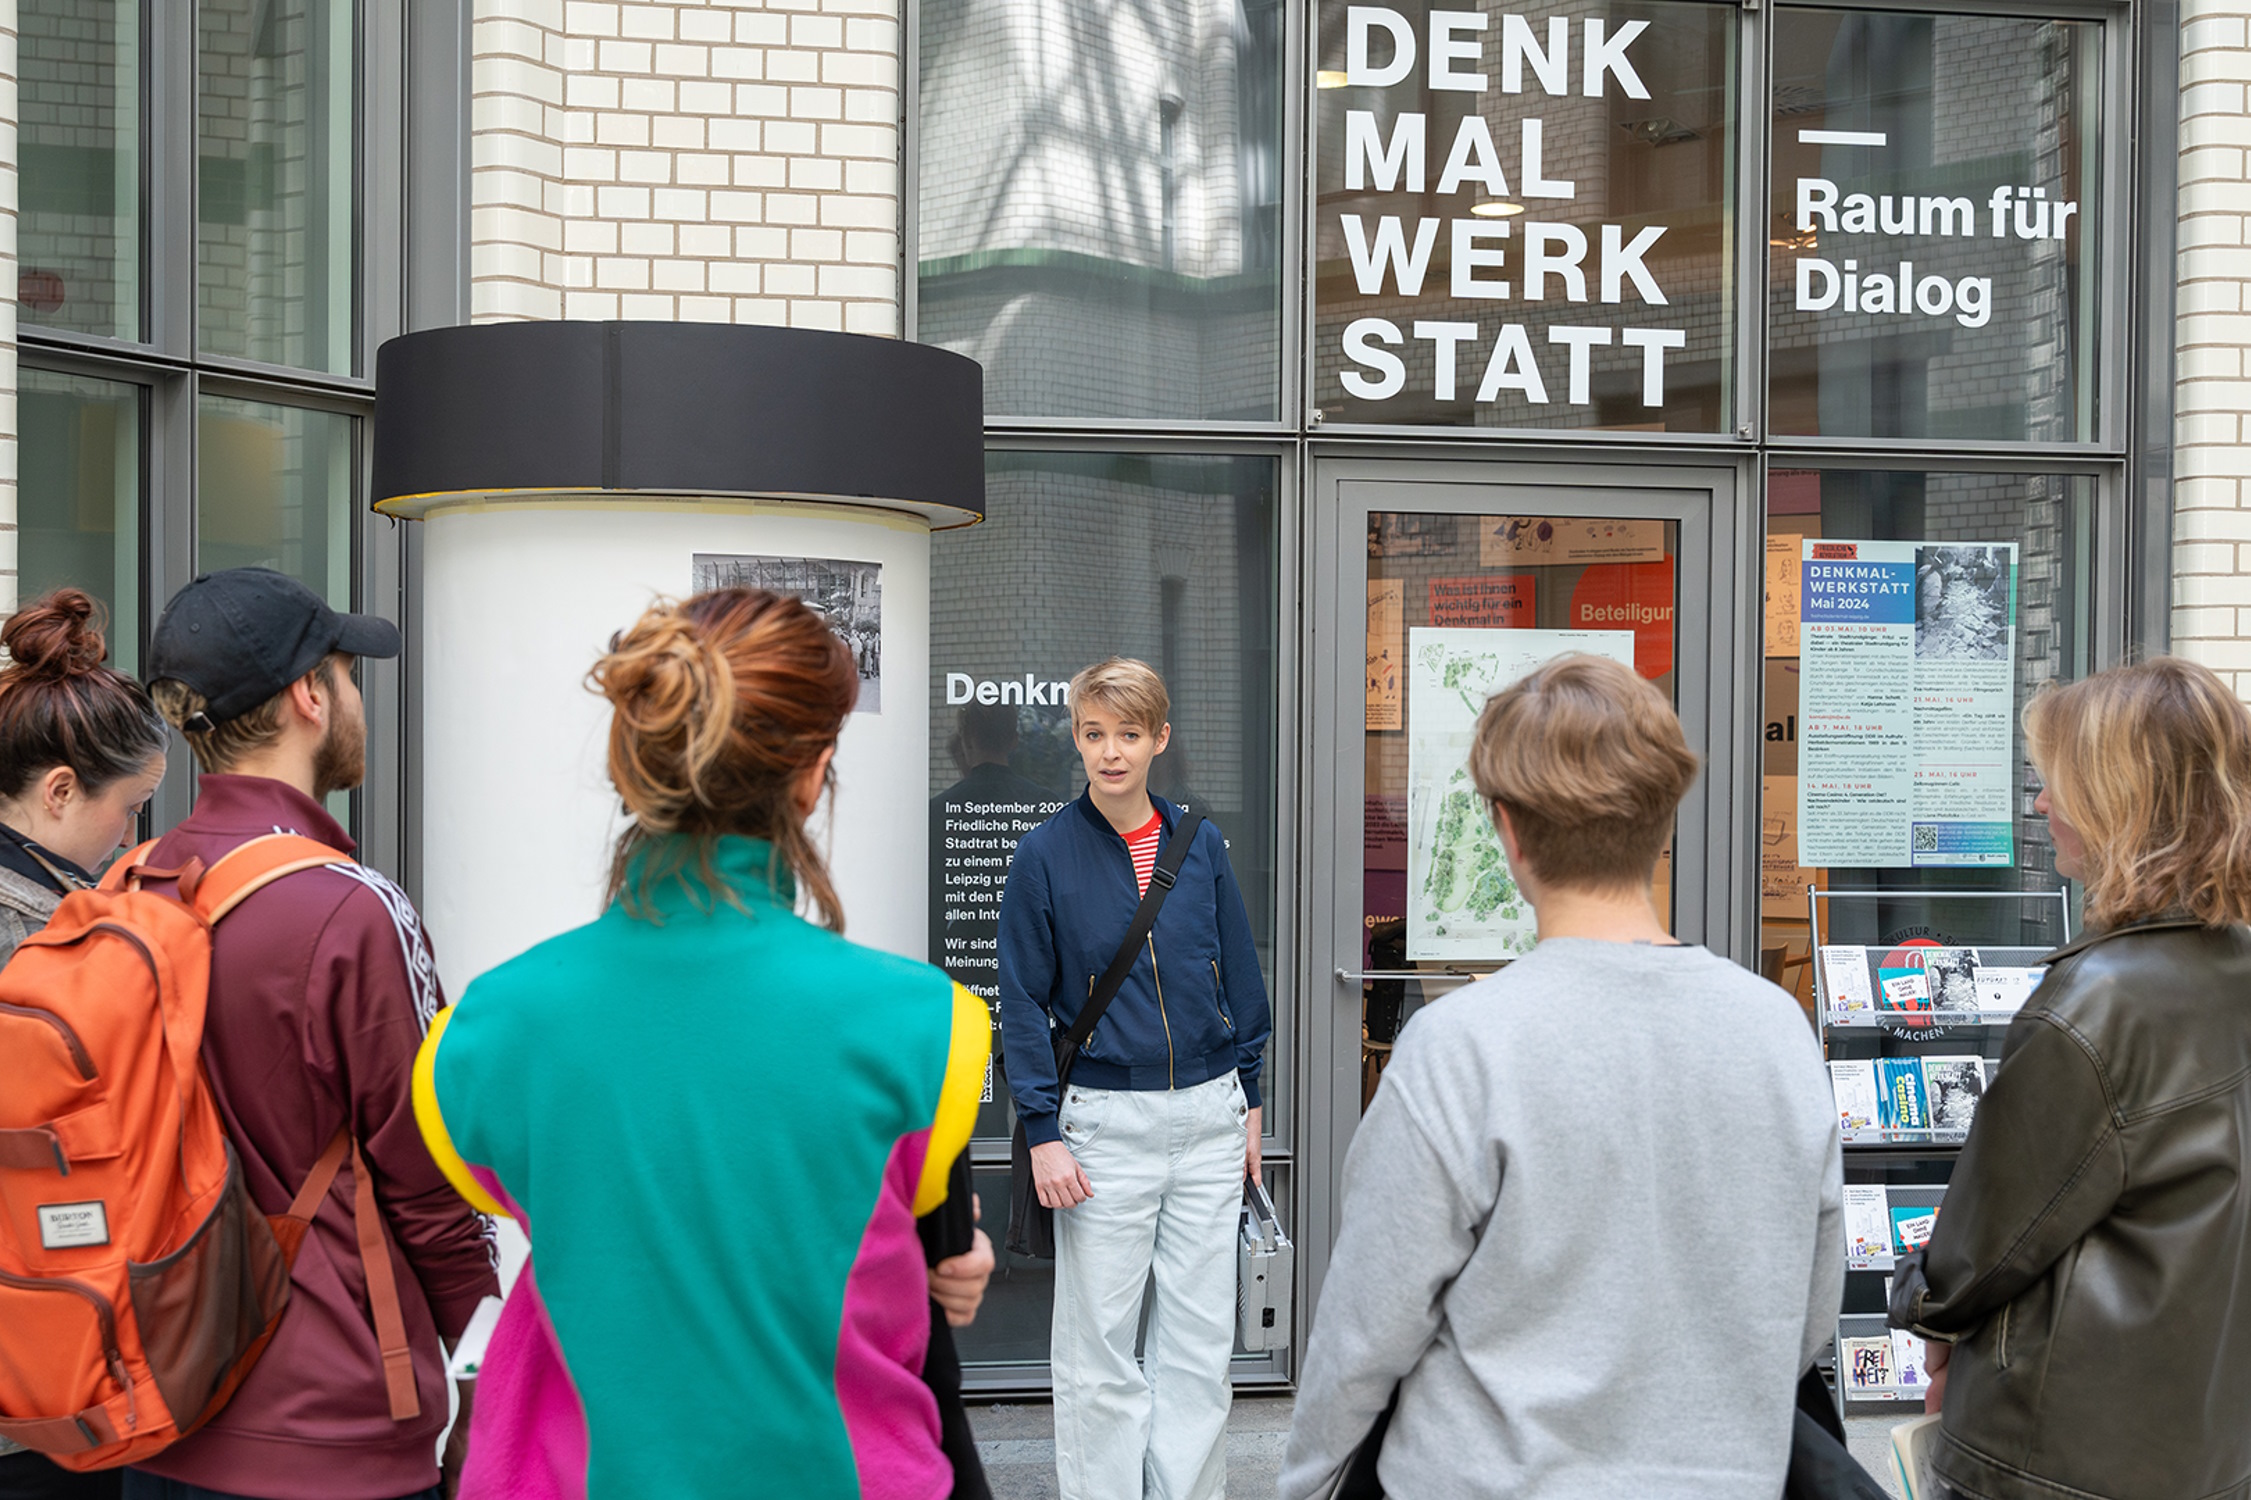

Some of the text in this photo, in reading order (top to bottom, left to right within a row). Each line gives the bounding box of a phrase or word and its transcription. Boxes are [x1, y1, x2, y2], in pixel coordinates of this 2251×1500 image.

[1346, 6, 1651, 100] DENK
[1344, 110, 1576, 199] MAL
[1797, 178, 2077, 241] Raum für
[1340, 214, 1669, 306] WERK
[1795, 258, 1992, 329] Dialog
[1339, 317, 1685, 408] STATT
[1810, 566, 1896, 579] DENKMAL-
[1434, 582, 1516, 597] Was ist Ihnen
[1810, 581, 1910, 594] WERKSTATT
[1434, 597, 1522, 612] wichtig für ein
[1810, 597, 1870, 610] Mai 2024
[1434, 612, 1504, 626] Denkmal in
[944, 801, 1069, 816] Im September 202
[945, 819, 1009, 831] Friedliche
[945, 837, 999, 849] Stadtrat
[945, 857, 960, 867] zu
[963, 855, 1002, 867] einem
[945, 873, 991, 886] Leipzig
[945, 890, 965, 902] mit
[968, 890, 993, 902] den
[945, 909, 975, 920] allen
[1886, 926, 1930, 944] KULTUR
[944, 938, 997, 950] Wir sind
[945, 956, 999, 969] Meinung
[1893, 1026, 1945, 1041] MACHEN
[1854, 1348, 1886, 1367] FREI
